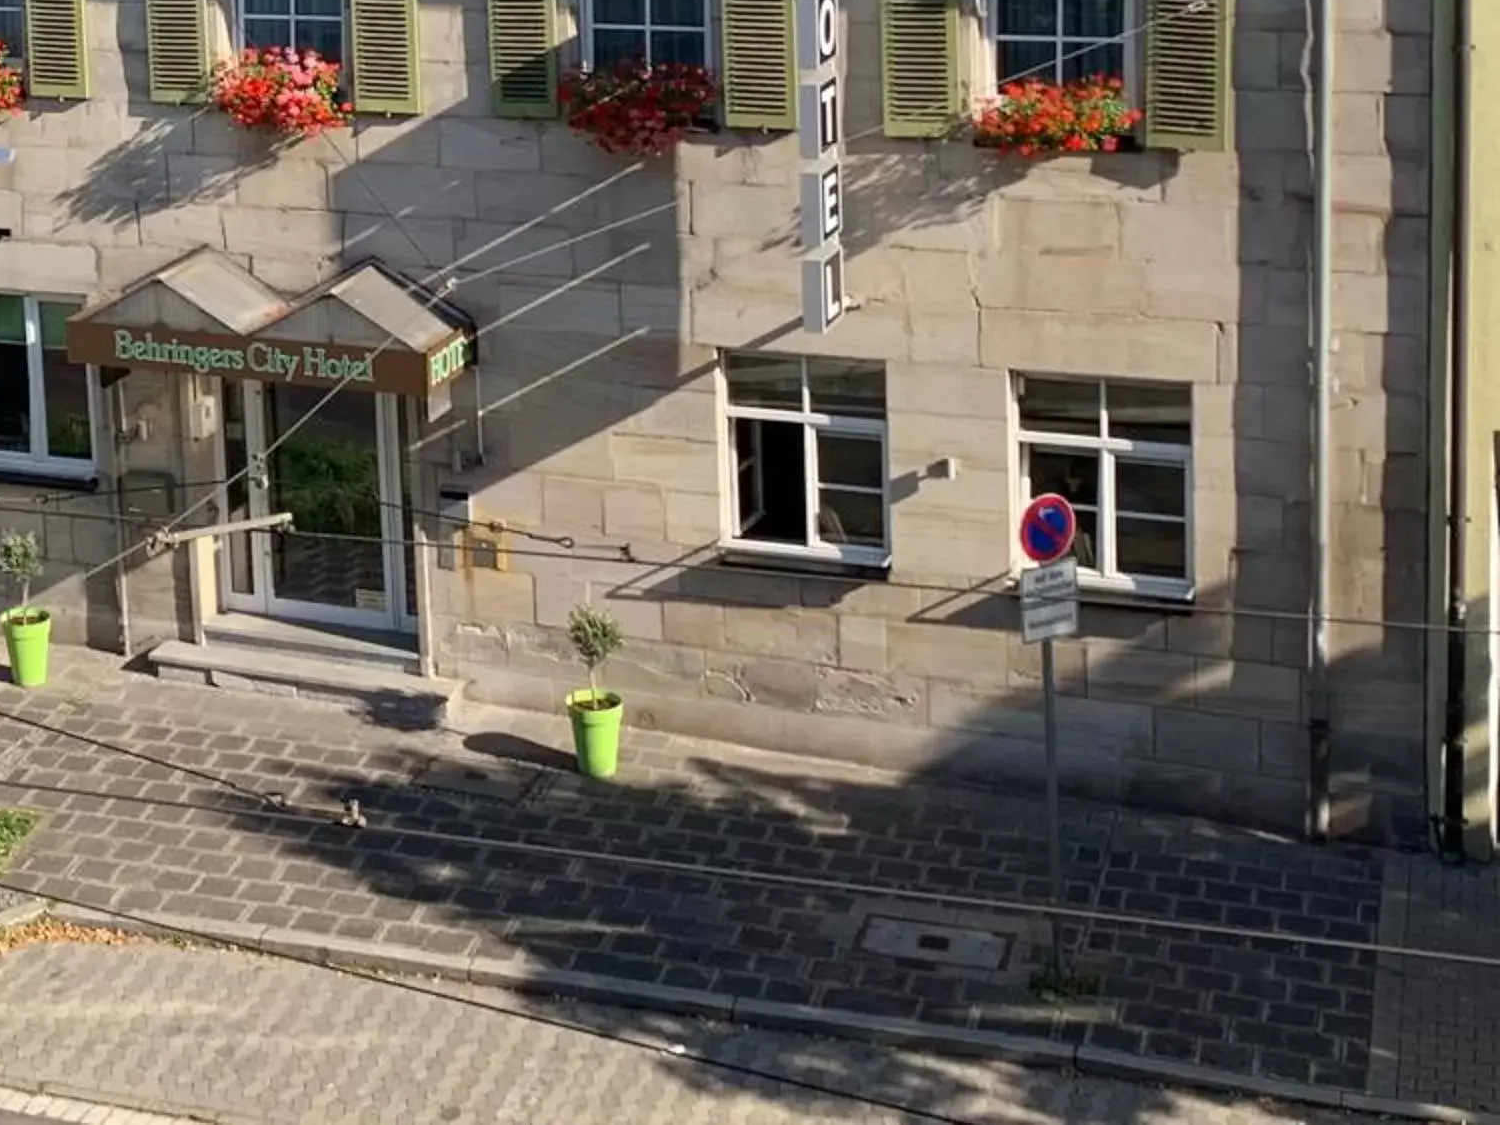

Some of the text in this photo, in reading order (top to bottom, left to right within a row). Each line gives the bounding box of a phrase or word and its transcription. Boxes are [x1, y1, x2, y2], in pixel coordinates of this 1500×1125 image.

[114, 329, 374, 382] Behringers City Hotel
